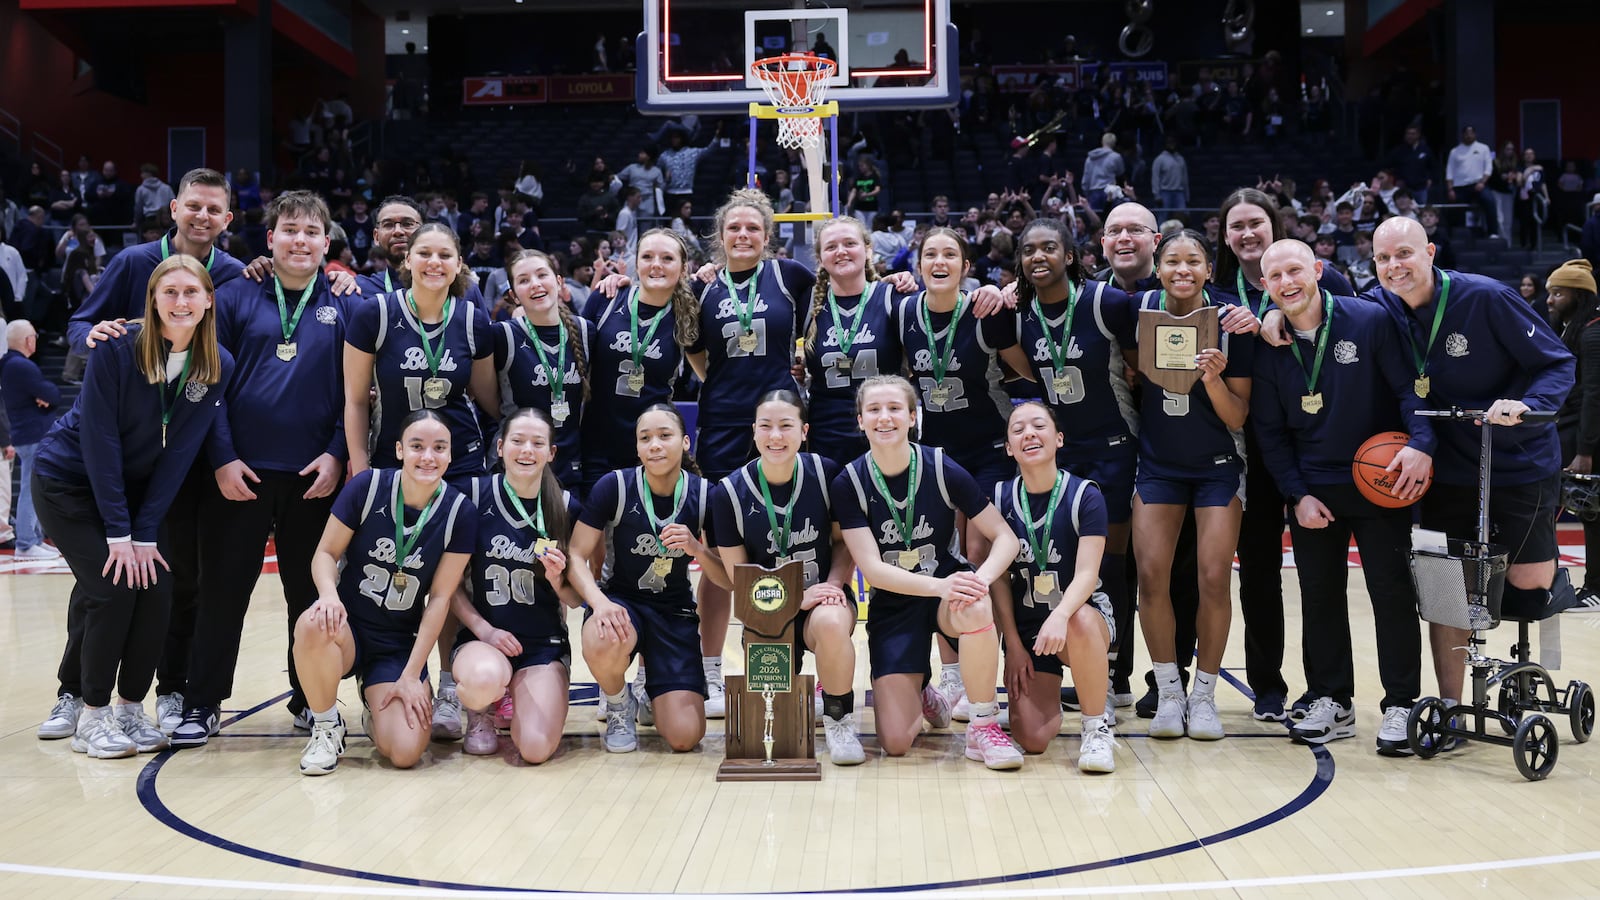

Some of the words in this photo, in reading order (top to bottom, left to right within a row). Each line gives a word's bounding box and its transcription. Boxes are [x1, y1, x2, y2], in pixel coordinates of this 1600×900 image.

[567, 81, 613, 95] LOYOLA
[1135, 70, 1163, 81] OUIS
[609, 330, 663, 359] Bds
[721, 317, 767, 358] 21
[822, 322, 876, 347] Bids
[399, 346, 458, 372] Bids
[820, 348, 880, 389] 24
[912, 348, 962, 372] Bds
[531, 362, 581, 387] Bds
[1039, 365, 1086, 405] 10
[918, 376, 969, 412] 22
[878, 514, 935, 544] Bids
[367, 537, 425, 569] Bids
[630, 533, 686, 558] Bids
[1014, 537, 1062, 564] Bids
[358, 563, 421, 611] 20
[484, 564, 536, 606] 30
[637, 561, 667, 594] 4
[1019, 567, 1064, 611] 14
[749, 648, 764, 663] STATE
[759, 665, 780, 674] 2026
